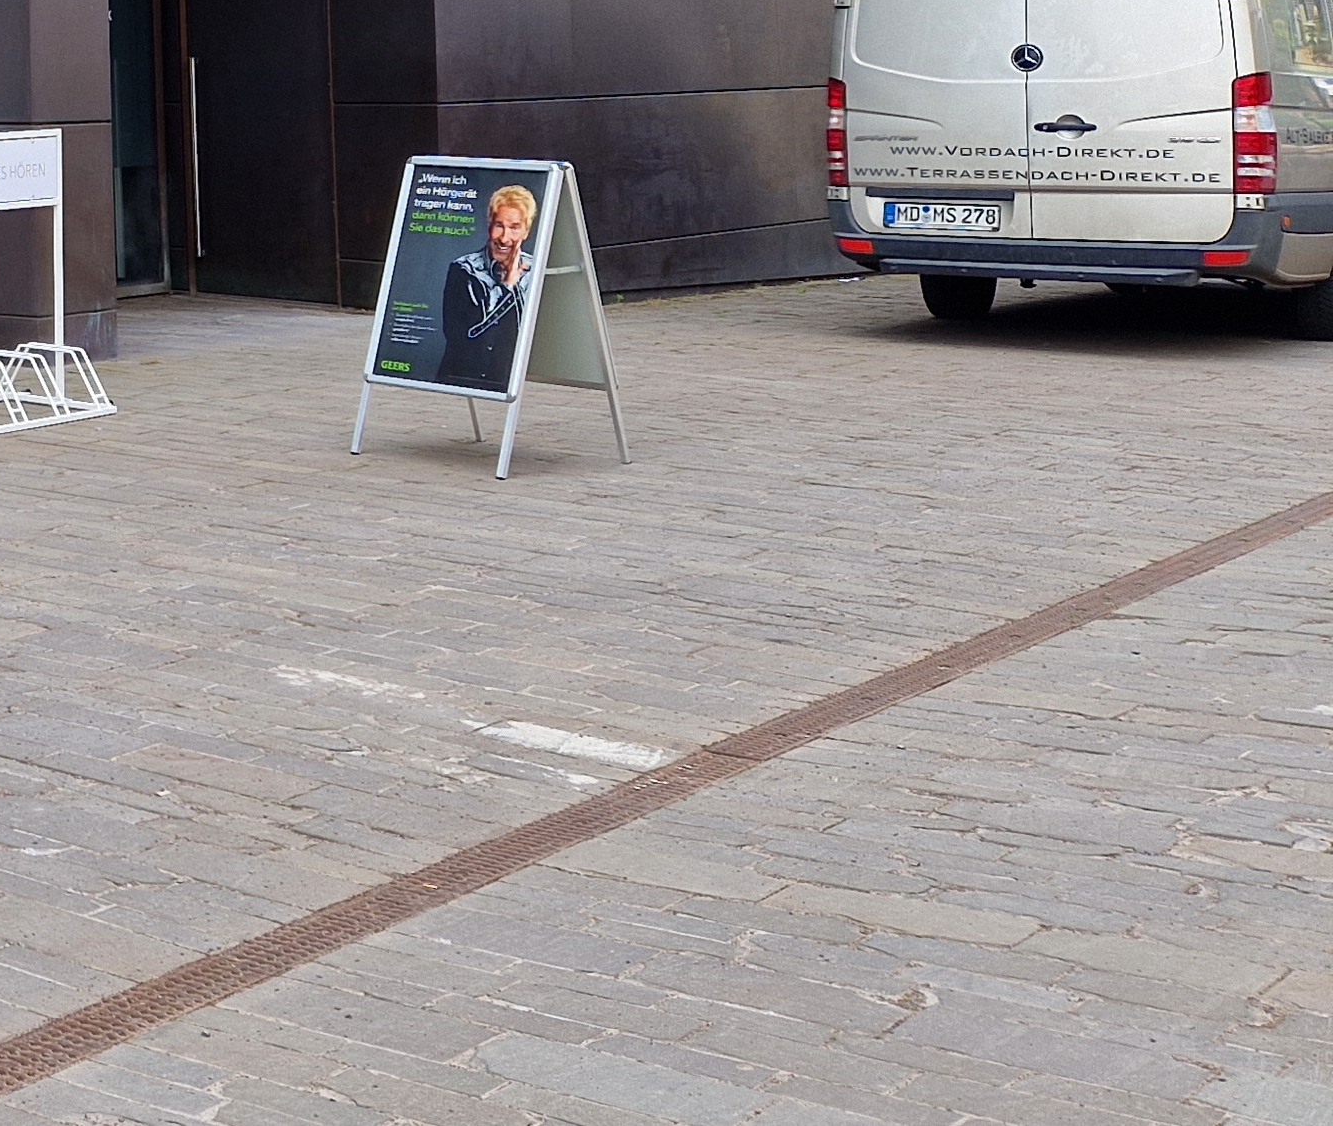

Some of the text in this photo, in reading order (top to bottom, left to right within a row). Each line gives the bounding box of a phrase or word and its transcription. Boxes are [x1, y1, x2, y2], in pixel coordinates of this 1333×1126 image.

[9, 162, 46, 179] HÖREN
[452, 174, 467, 185] ich
[416, 185, 431, 195] ein
[414, 198, 446, 210] tragen
[897, 206, 996, 225] MD MS 278
[409, 222, 424, 232] Sie
[425, 223, 442, 233] das
[381, 360, 411, 372] GEERS
